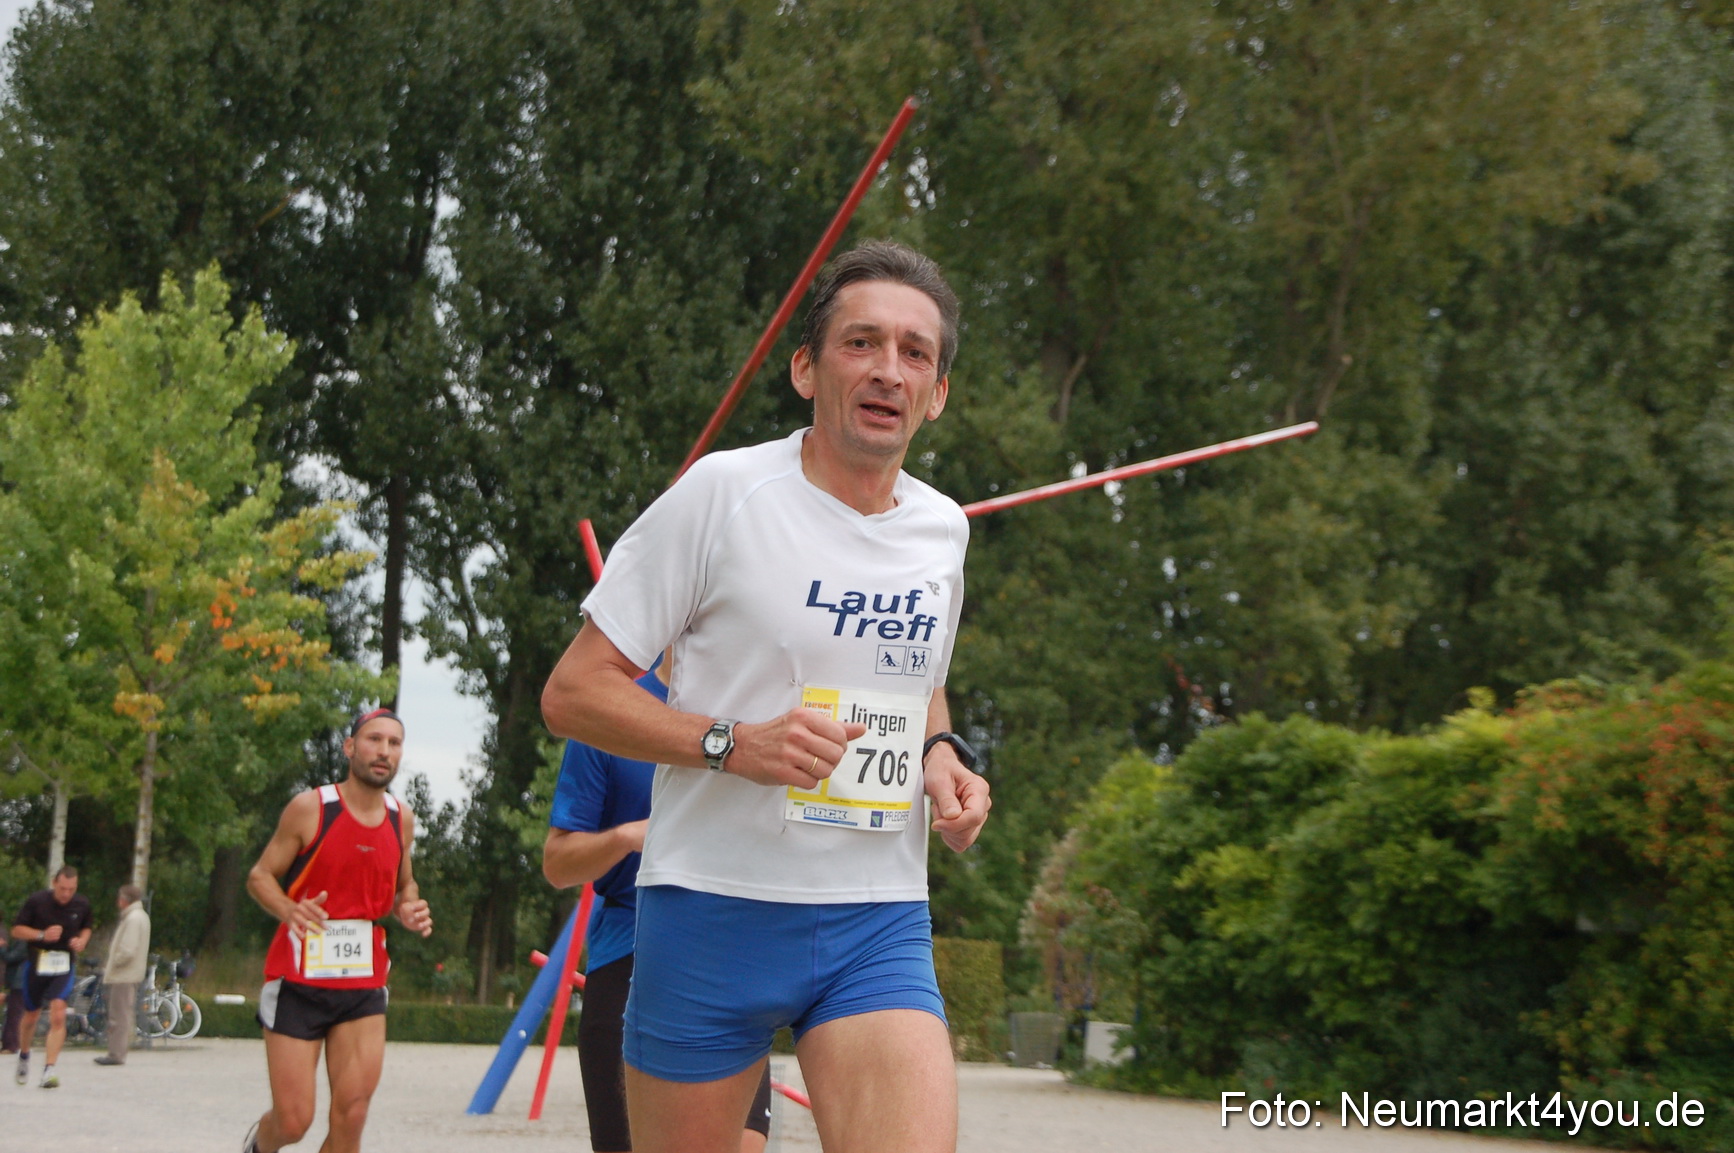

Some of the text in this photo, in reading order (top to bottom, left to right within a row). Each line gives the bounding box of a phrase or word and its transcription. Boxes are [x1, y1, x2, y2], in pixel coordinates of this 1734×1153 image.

[806, 580, 923, 614] Lauf
[829, 606, 938, 642] Treff
[845, 703, 907, 737] Jürgen
[856, 748, 909, 787] 706
[804, 806, 848, 820] BOCK
[326, 926, 357, 936] Steffen
[333, 942, 363, 958] 194
